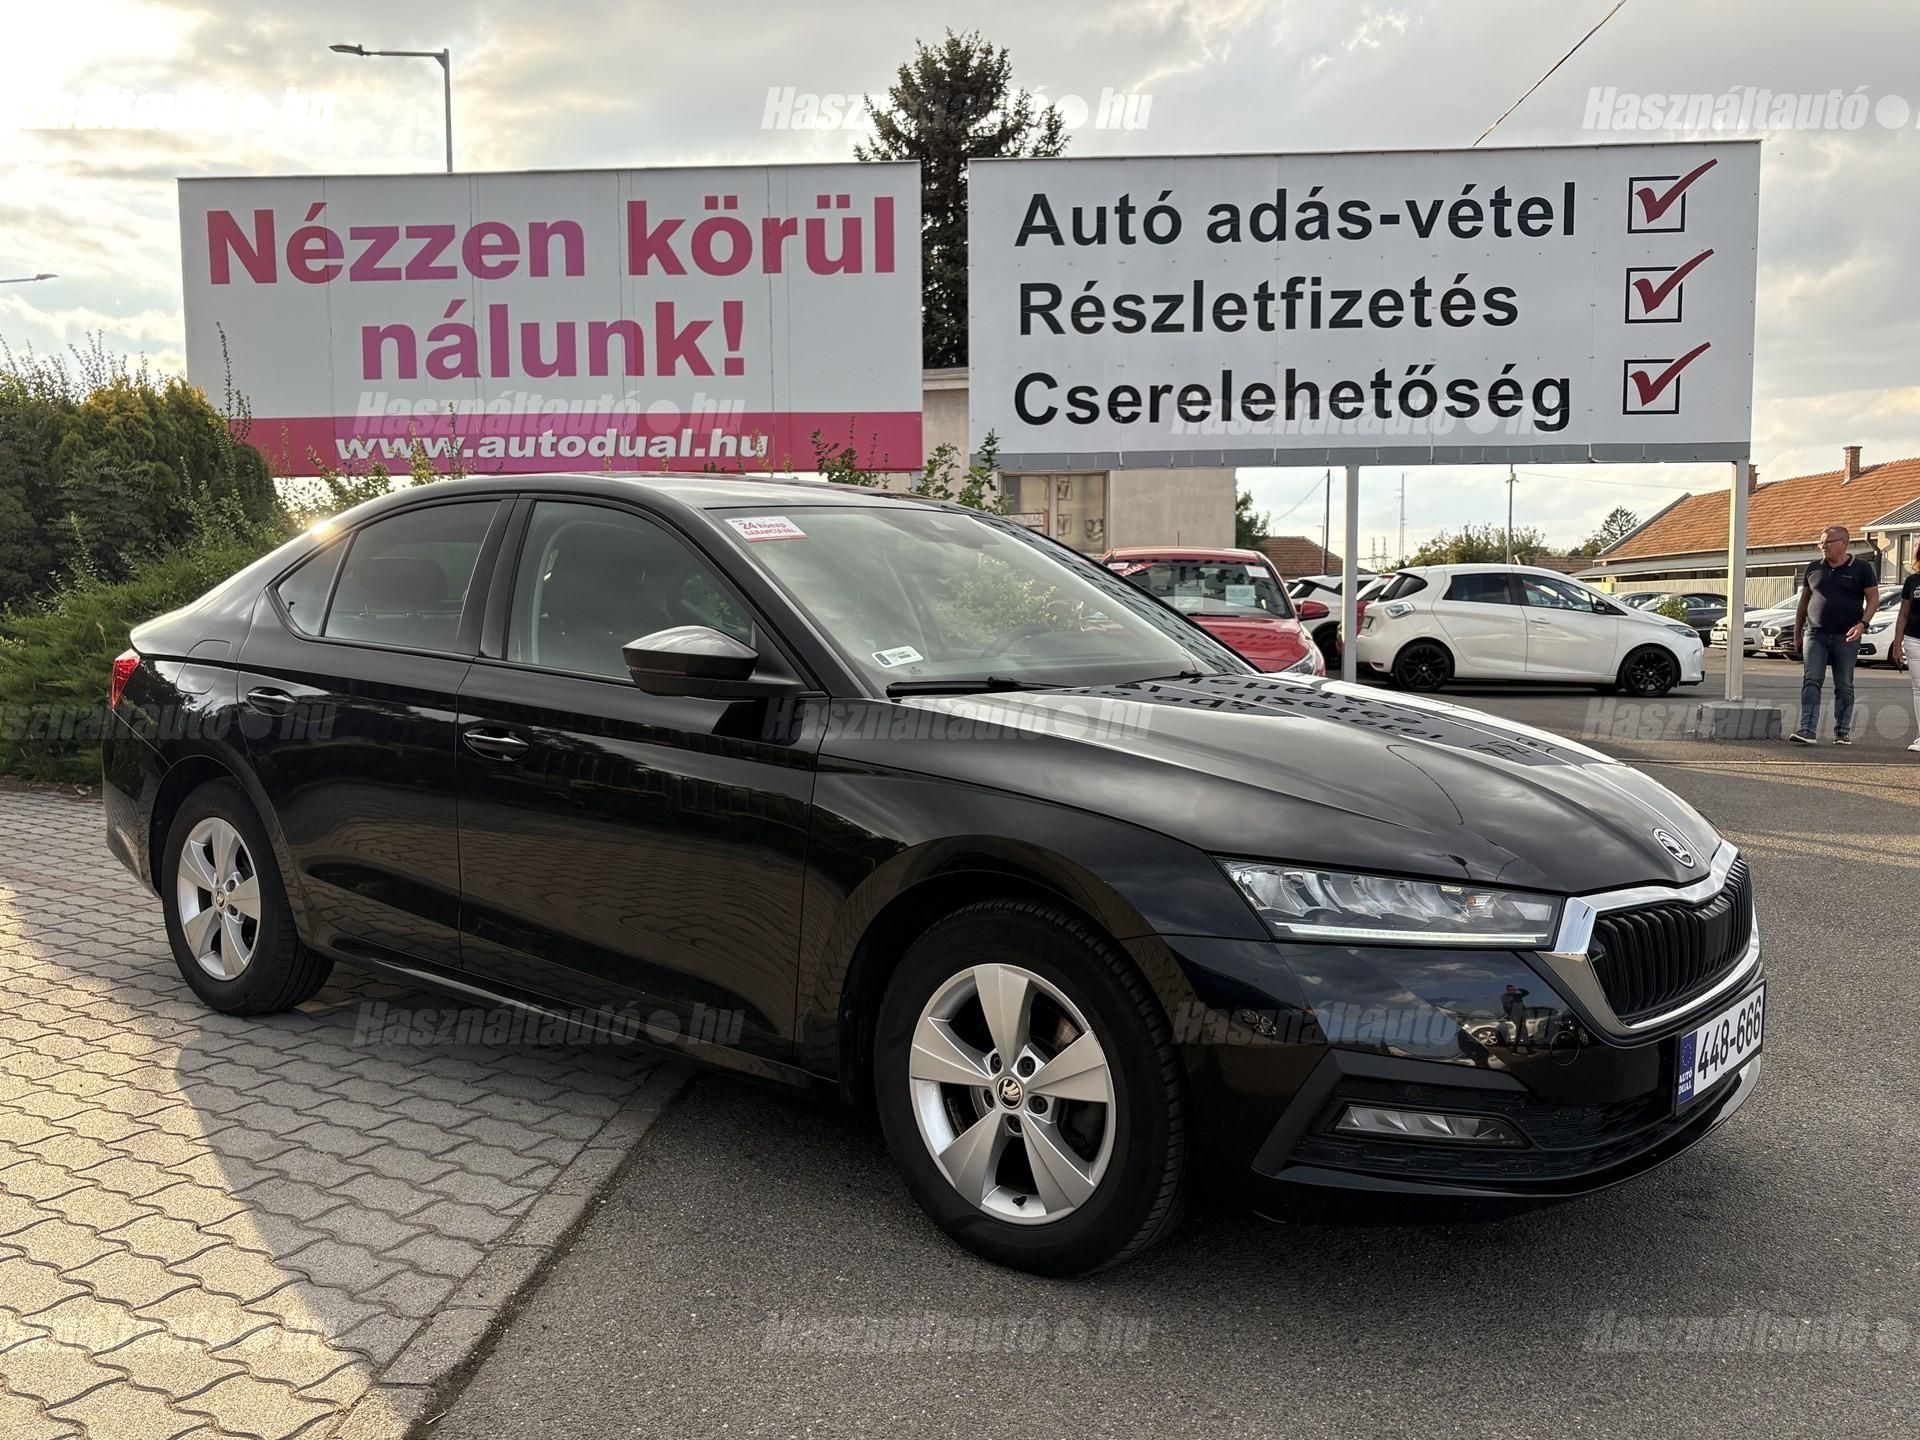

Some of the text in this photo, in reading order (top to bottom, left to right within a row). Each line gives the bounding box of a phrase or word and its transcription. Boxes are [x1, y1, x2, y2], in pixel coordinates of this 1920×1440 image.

[207, 195, 895, 285] Nézzen körül
[1014, 181, 1576, 247] Autó adás-vétel
[1020, 272, 1519, 336] Részletfizetés
[361, 300, 746, 380] nálunk!
[1014, 363, 1570, 432] Cserelehetőség
[335, 427, 769, 462] www.autodual.hu
[1697, 994, 1762, 1080] 448-666
